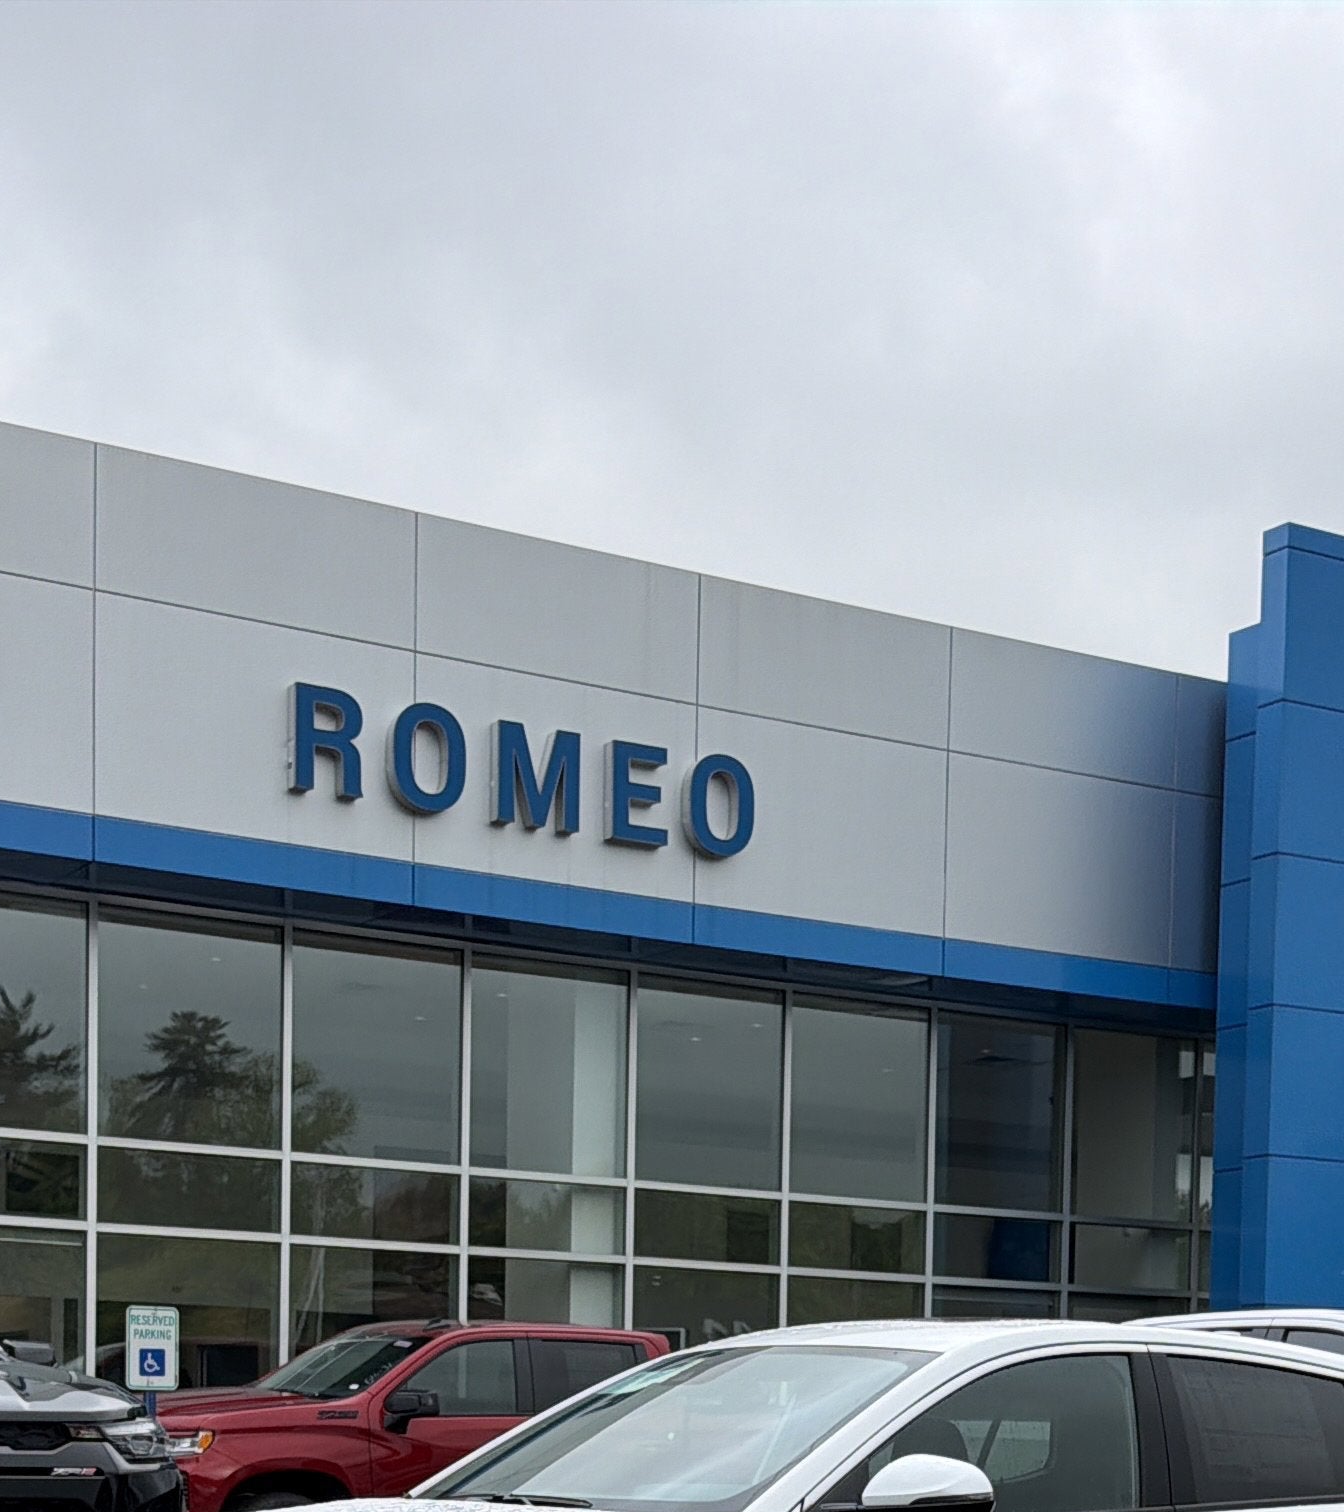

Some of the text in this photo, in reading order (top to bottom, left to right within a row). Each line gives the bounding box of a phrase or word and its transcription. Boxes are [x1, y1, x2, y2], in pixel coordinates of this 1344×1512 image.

[288, 682, 755, 859] ROMEO
[130, 1314, 175, 1326] RESERVED
[133, 1328, 172, 1340] PARKING
